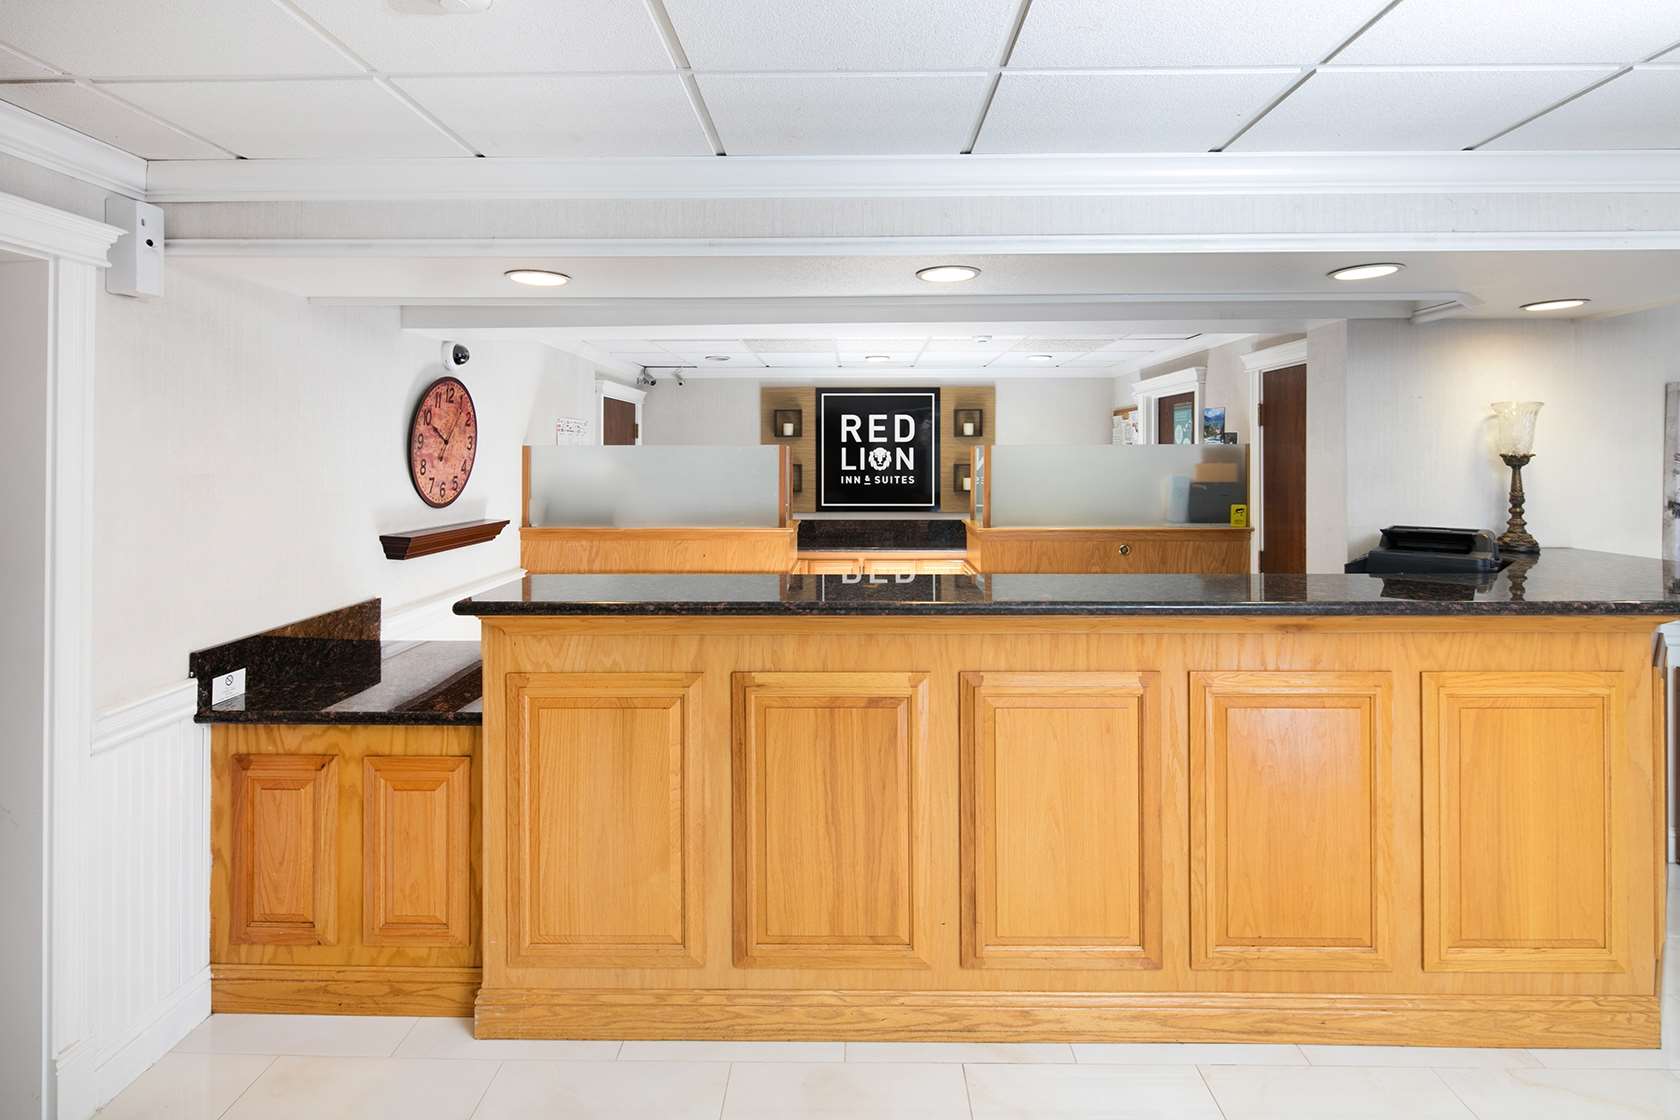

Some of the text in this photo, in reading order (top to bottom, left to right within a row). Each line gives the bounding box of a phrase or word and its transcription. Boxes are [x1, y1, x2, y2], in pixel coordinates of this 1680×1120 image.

[435, 392, 442, 408] 11
[446, 386, 455, 403] 12
[423, 409, 432, 425] 10
[465, 412, 471, 427] 2
[841, 414, 916, 443] RED
[417, 434, 424, 449] 9
[466, 436, 473, 450] 3
[420, 459, 427, 475] 8
[461, 459, 467, 473] 4
[428, 478, 435, 493] 7
[452, 476, 459, 490] 5
[841, 475, 915, 485] INN & SUITES
[439, 482, 446, 497] 6
